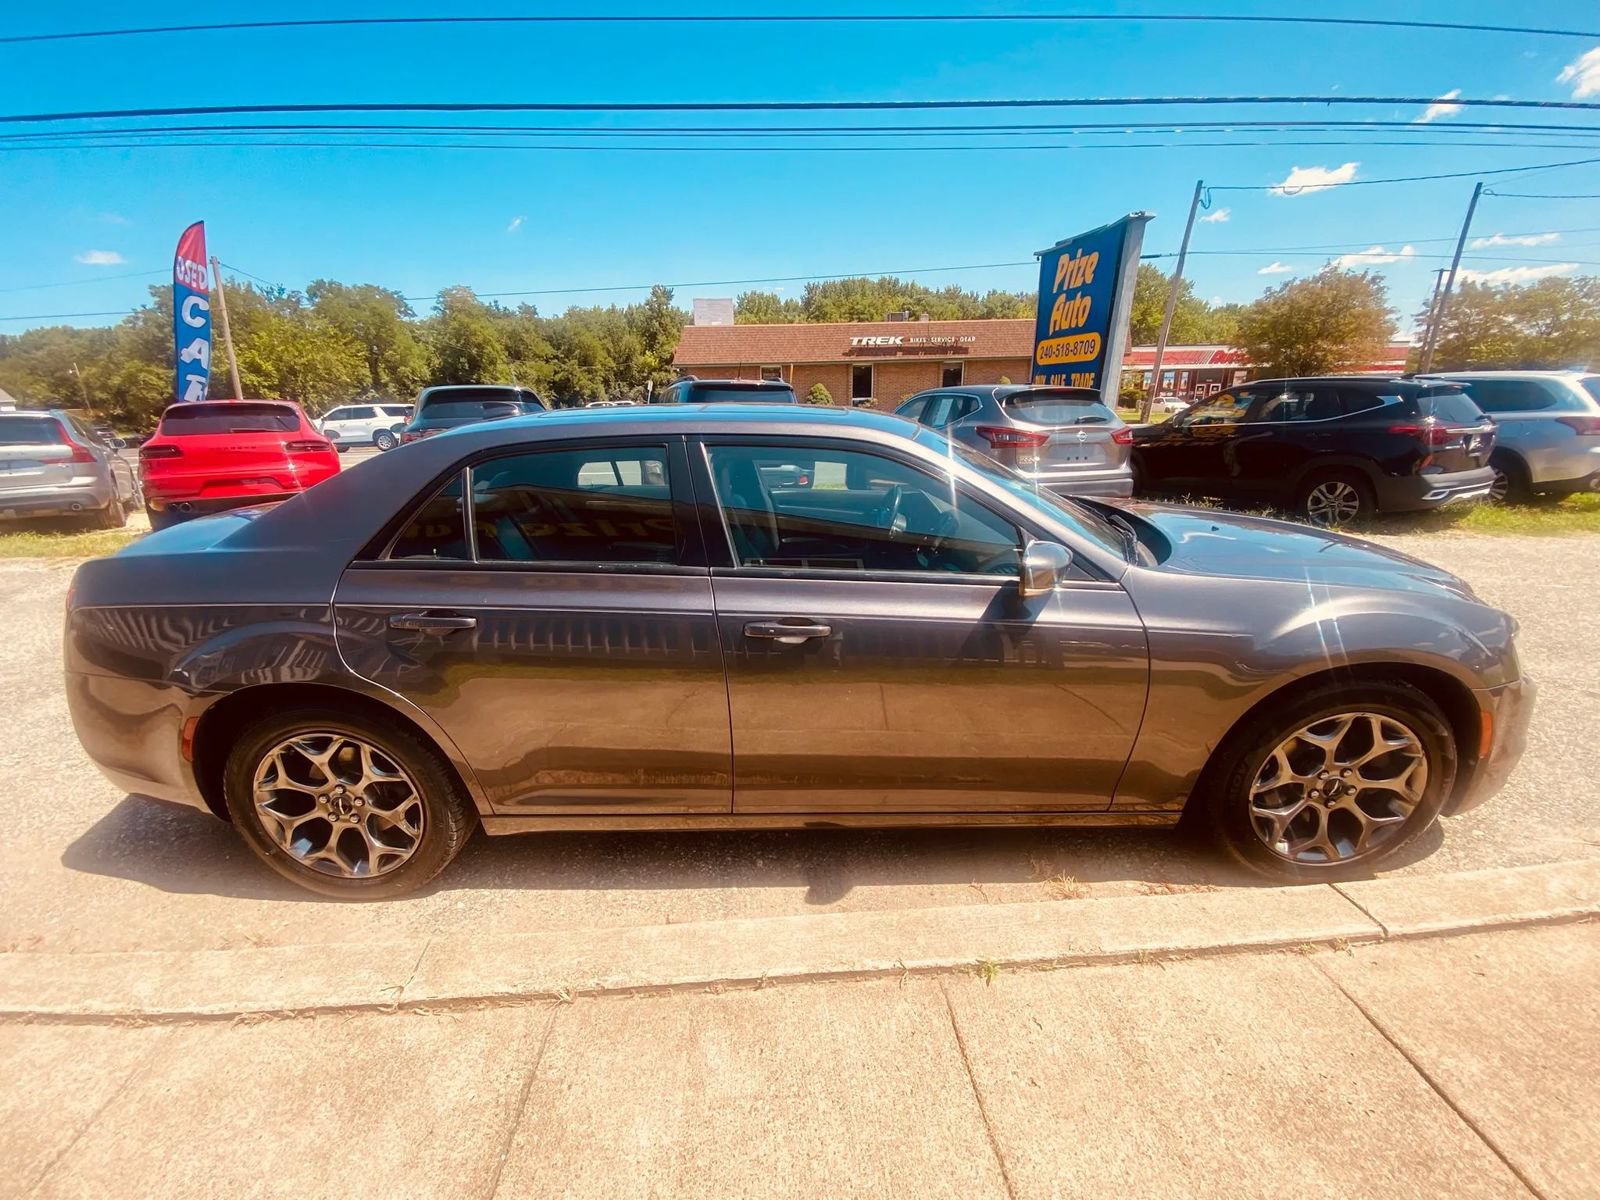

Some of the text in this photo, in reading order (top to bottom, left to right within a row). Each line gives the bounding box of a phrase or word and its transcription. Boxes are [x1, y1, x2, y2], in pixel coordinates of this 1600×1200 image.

[176, 256, 208, 290] USED
[1053, 248, 1100, 294] Prize
[1049, 291, 1092, 336] Auto
[849, 336, 904, 346] TREK
[1039, 338, 1096, 360] 240-518-8709
[1071, 372, 1095, 388] TRADE
